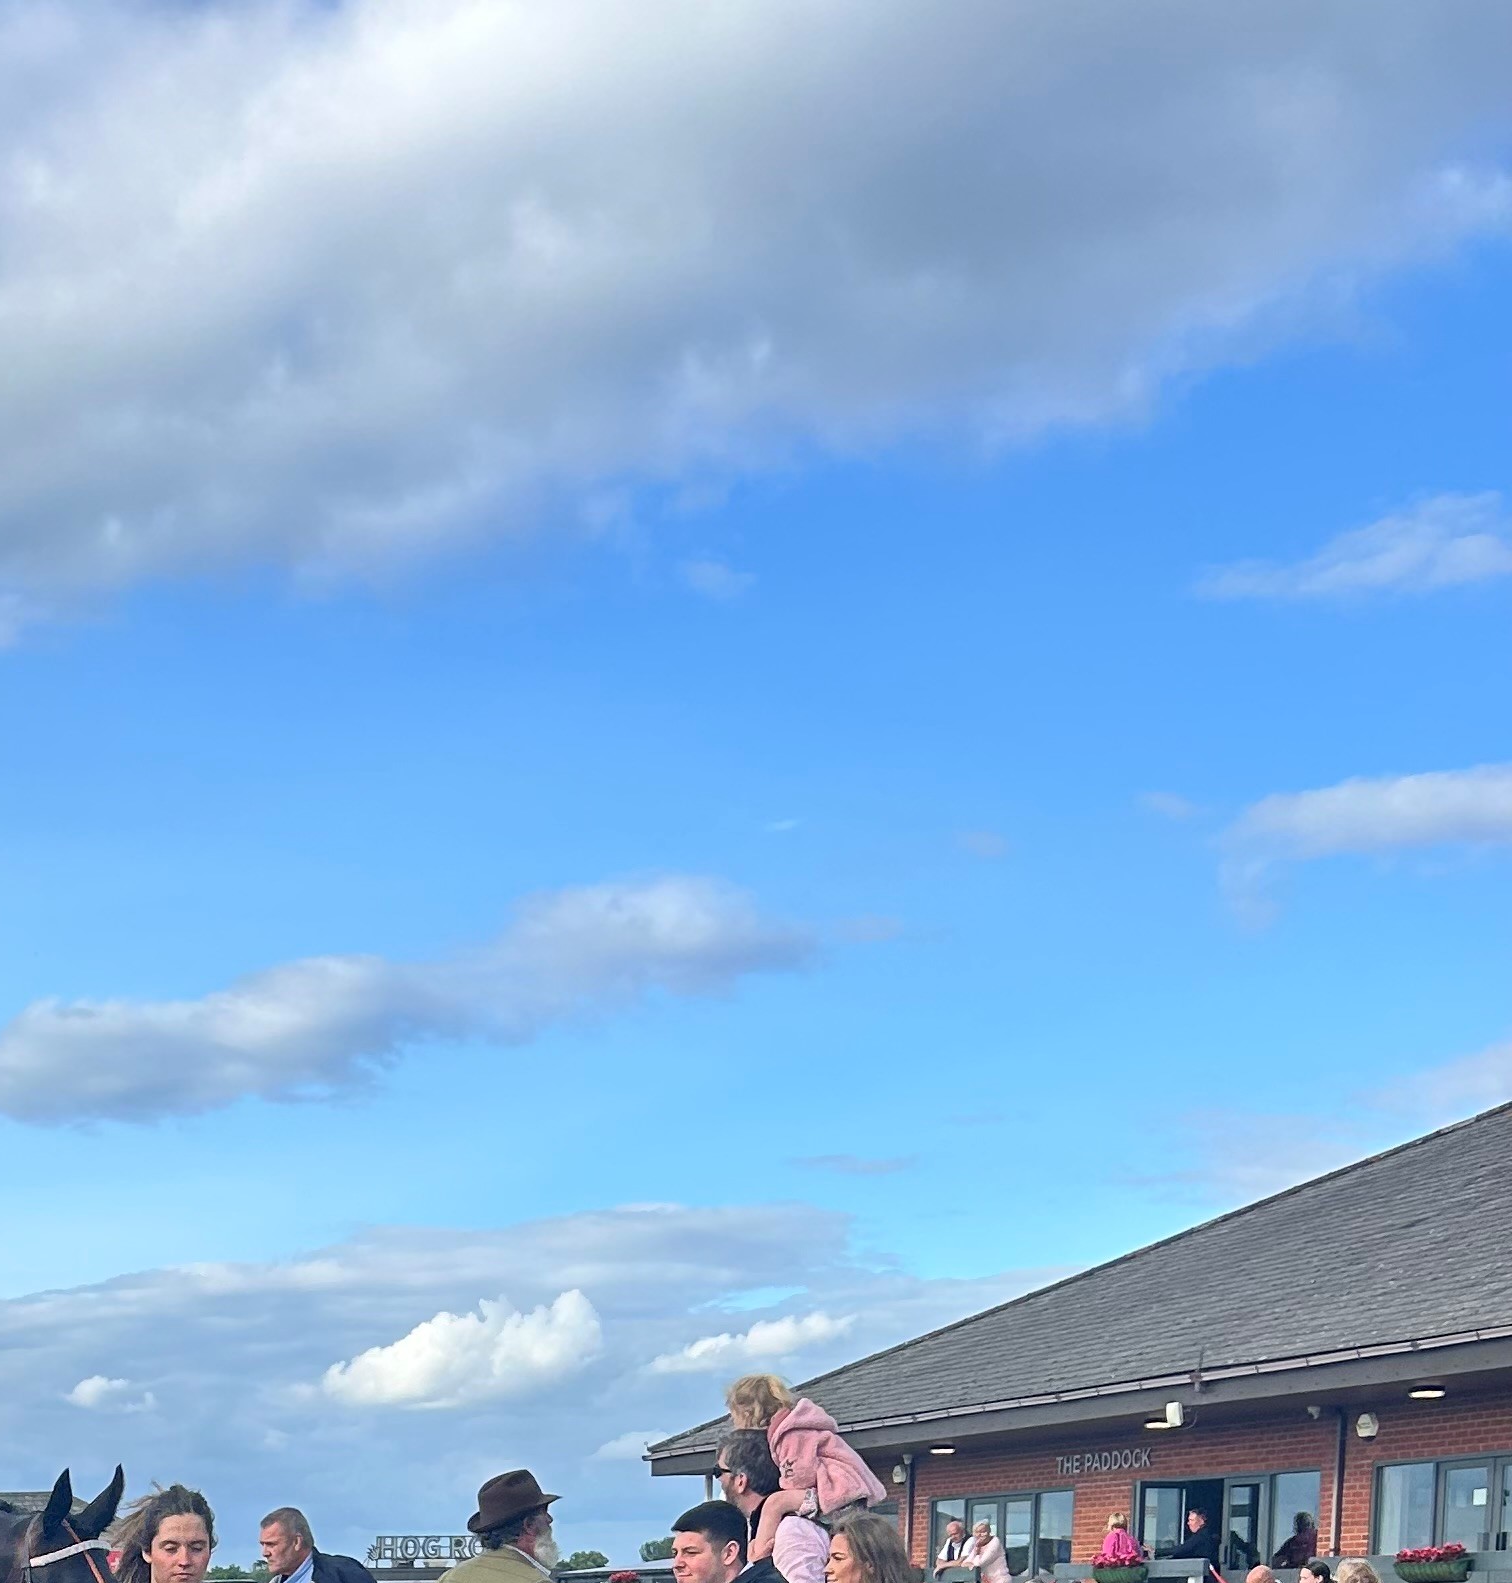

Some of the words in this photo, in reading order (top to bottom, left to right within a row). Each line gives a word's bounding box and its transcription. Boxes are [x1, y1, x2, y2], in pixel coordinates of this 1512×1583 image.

[1056, 1455, 1081, 1475] THE
[1084, 1447, 1152, 1473] PADDOCK
[376, 1536, 442, 1560] HOG
